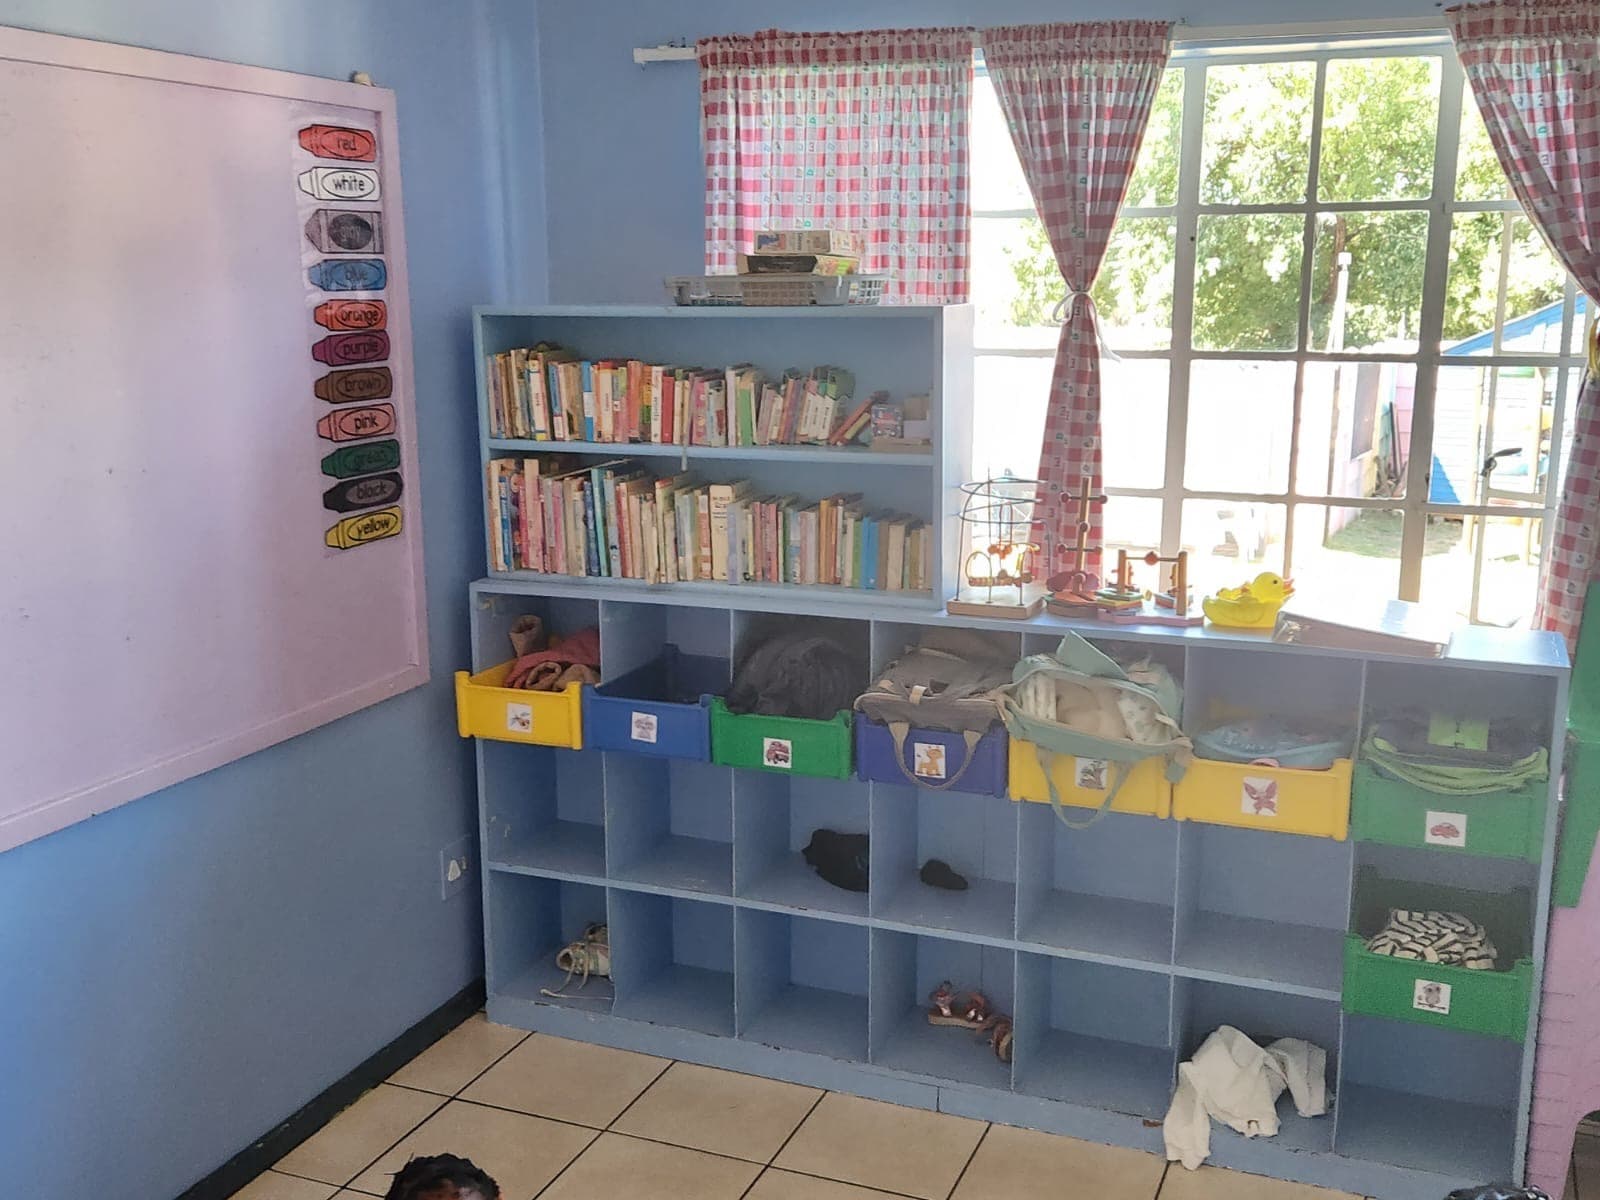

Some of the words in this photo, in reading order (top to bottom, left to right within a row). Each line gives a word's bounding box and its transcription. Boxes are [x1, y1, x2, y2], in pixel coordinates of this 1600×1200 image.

[337, 135, 357, 151] red
[333, 175, 366, 192] white
[341, 309, 379, 327] orange
[343, 339, 379, 356] purple
[344, 375, 380, 393] brown
[353, 413, 378, 433] pink
[356, 481, 387, 499] black
[357, 514, 391, 539] yellow
